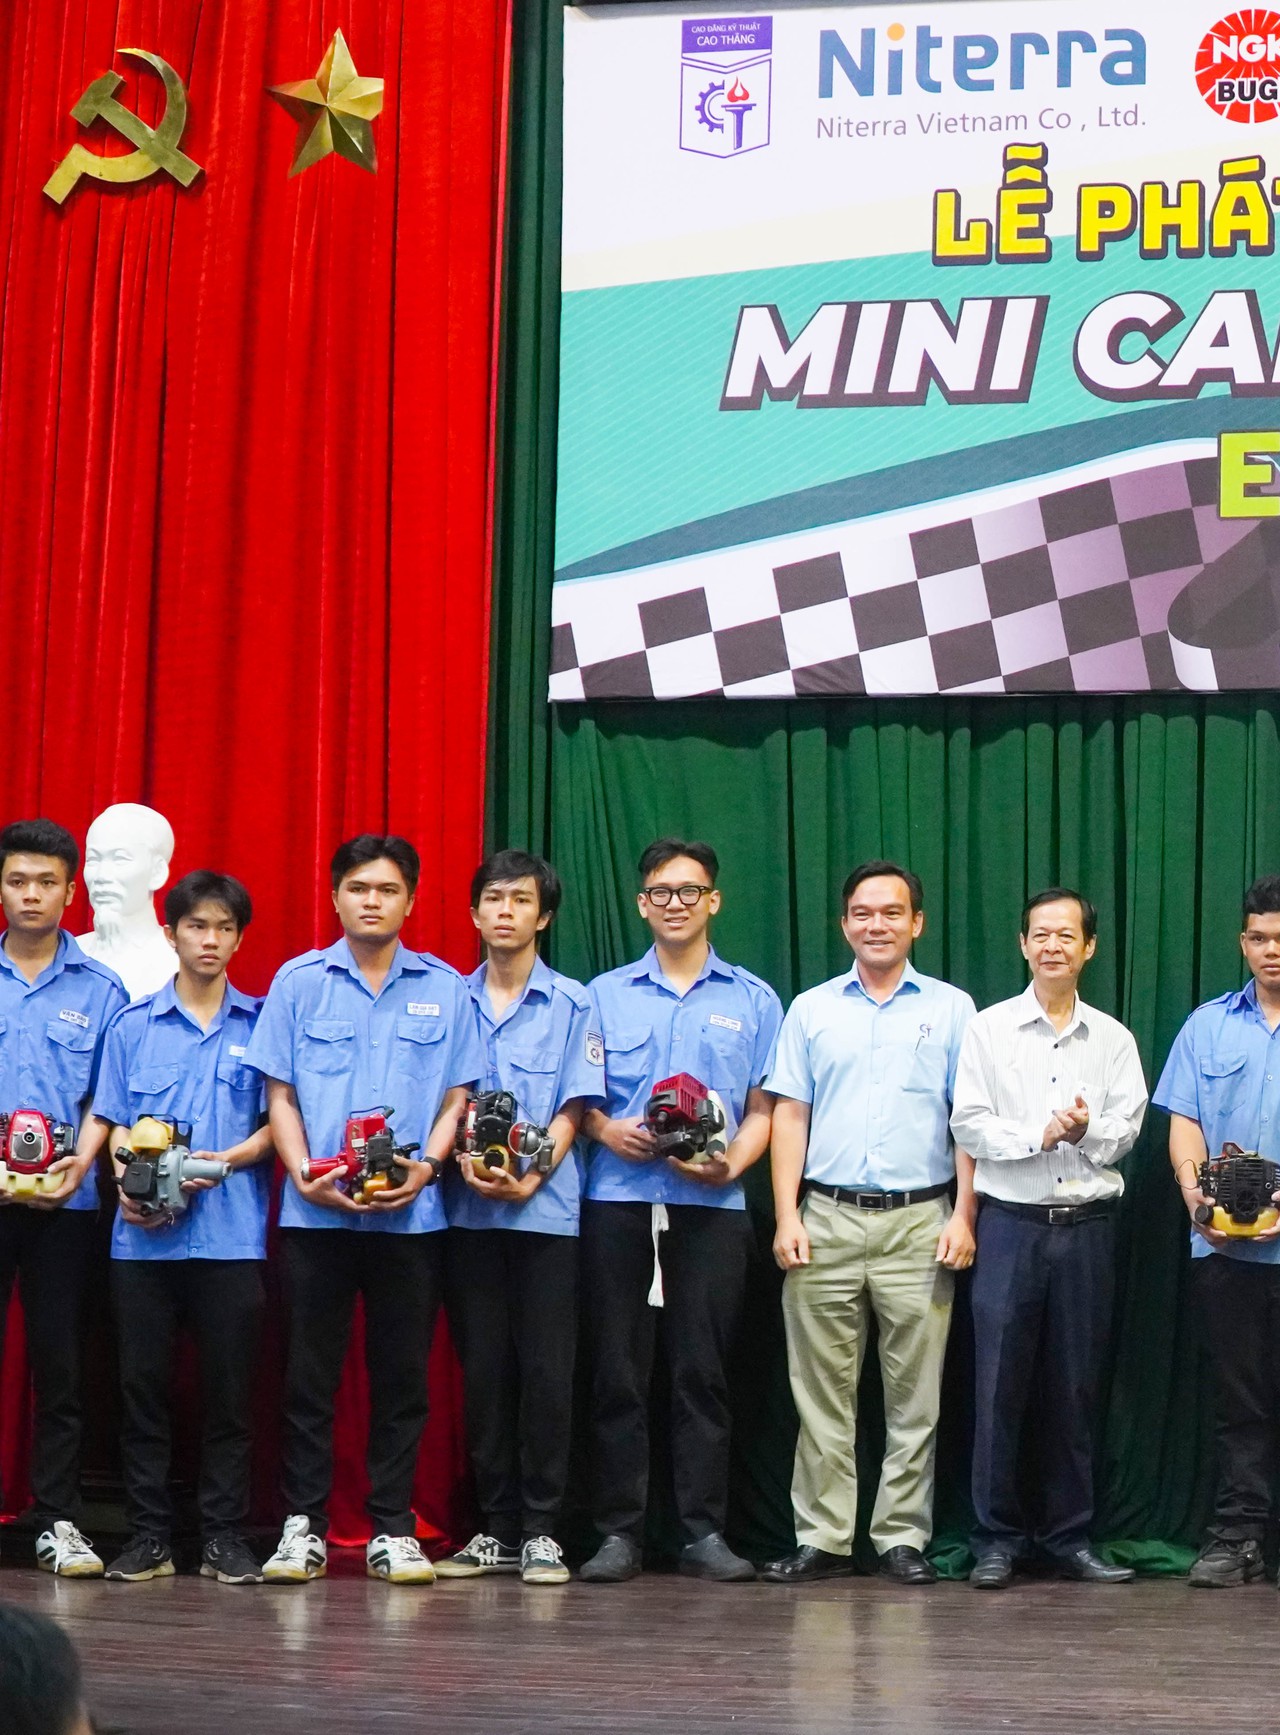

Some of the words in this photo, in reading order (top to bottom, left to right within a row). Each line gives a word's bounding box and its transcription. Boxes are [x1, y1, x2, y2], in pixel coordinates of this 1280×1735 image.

[696, 36, 718, 46] CAO
[818, 22, 1147, 99] Niterra
[816, 113, 907, 139] Niterra
[917, 110, 1029, 135] Vietnam
[1098, 104, 1147, 128] Ltd.
[931, 142, 1053, 266] LỄ
[719, 295, 1050, 411] MINI
